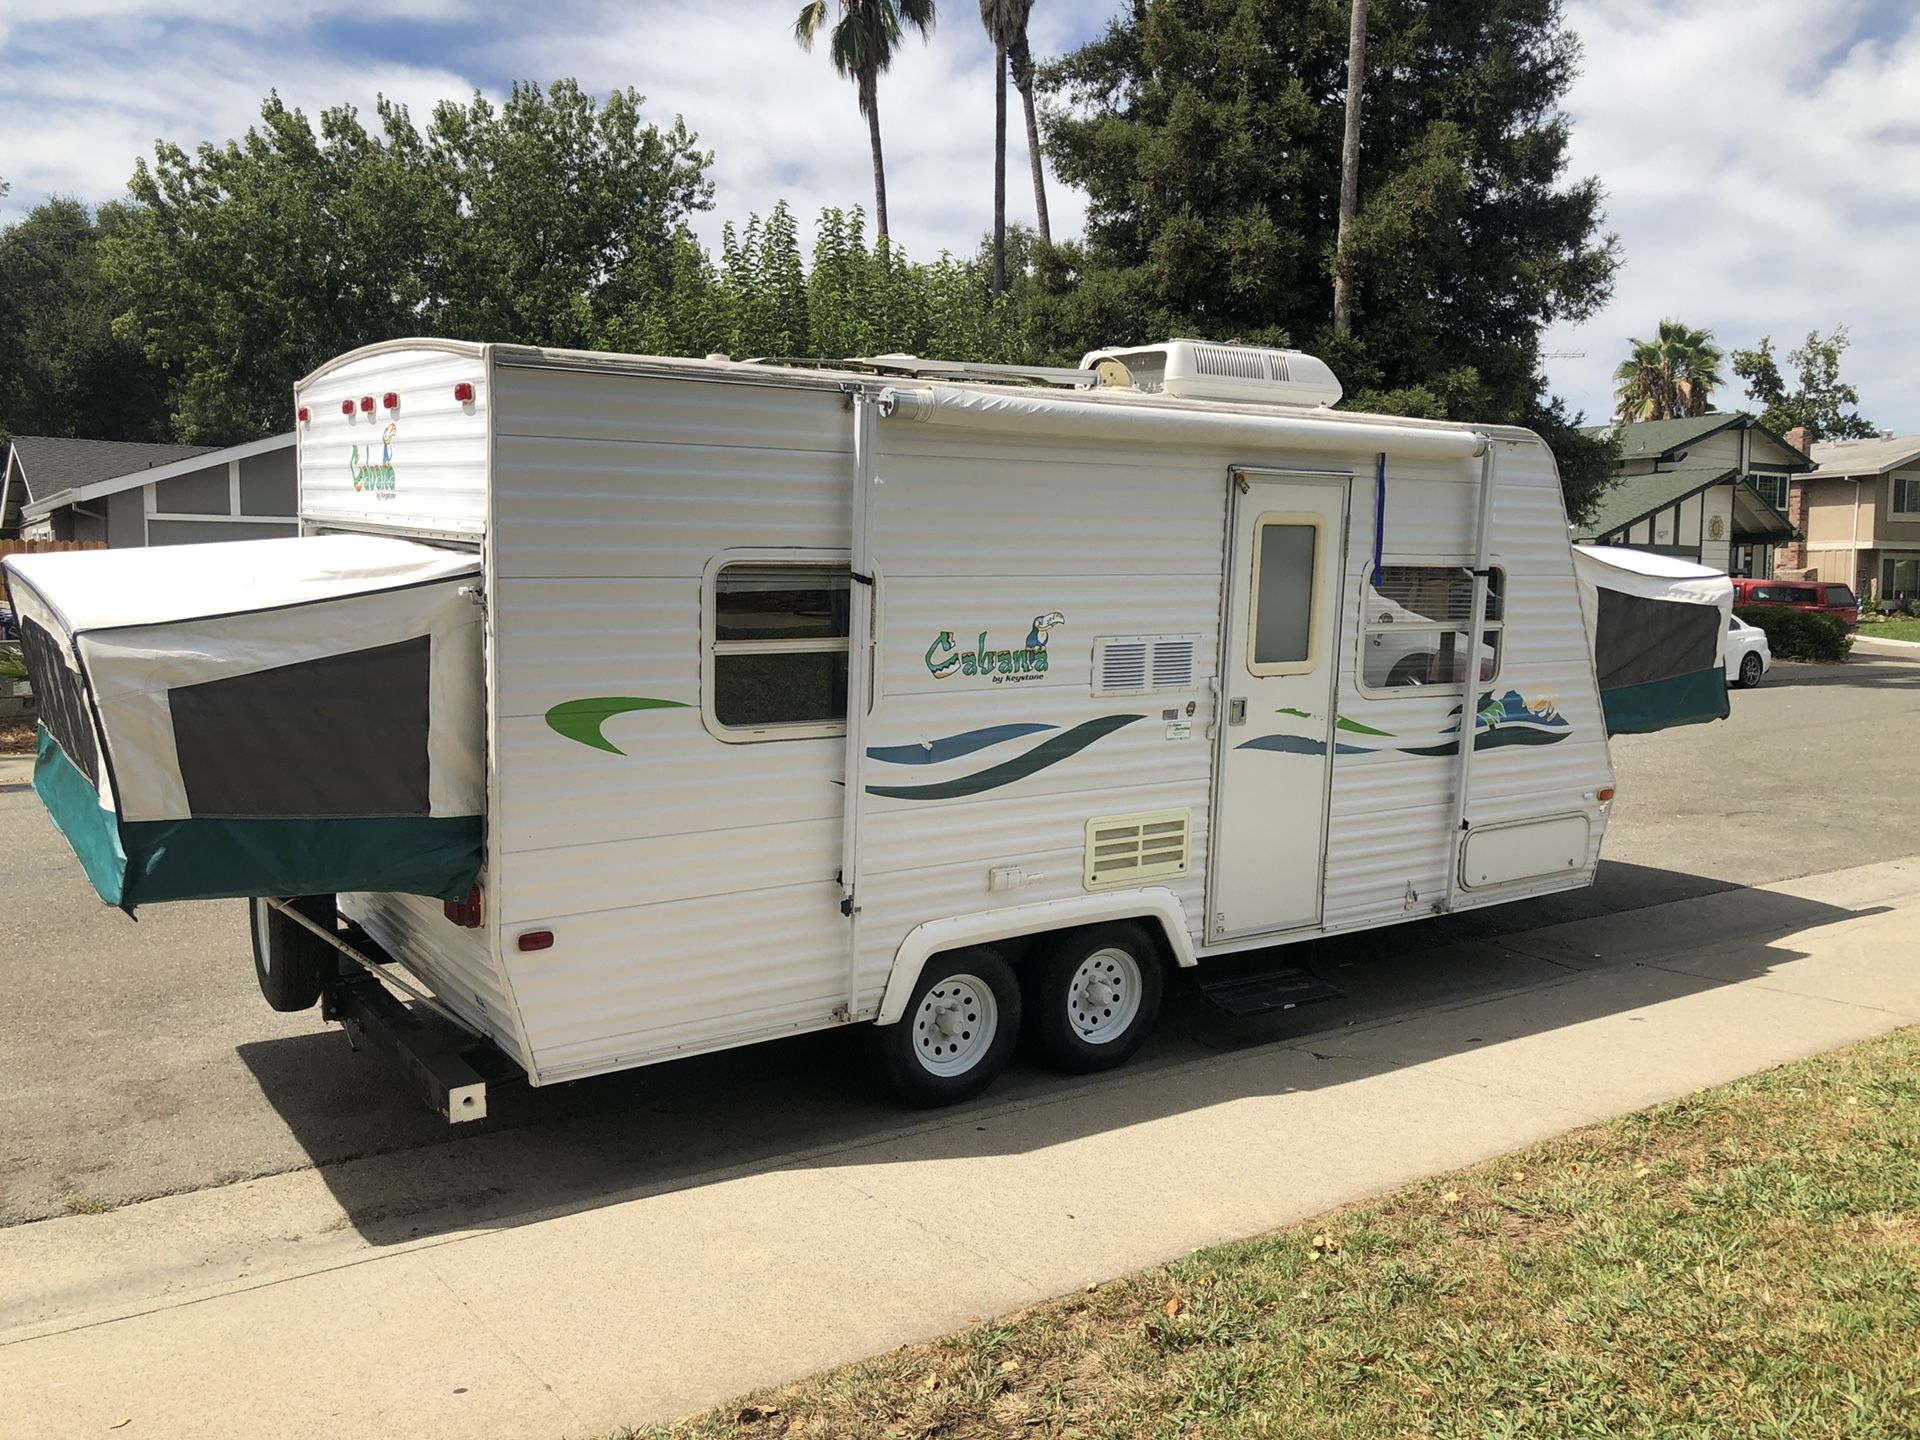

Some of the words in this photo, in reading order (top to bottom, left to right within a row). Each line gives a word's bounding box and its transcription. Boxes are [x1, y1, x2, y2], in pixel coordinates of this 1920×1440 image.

[350, 444, 395, 492] Cabana
[925, 631, 1049, 679] Cabana
[992, 675, 1003, 684] by
[1005, 673, 1045, 683] Keystone
